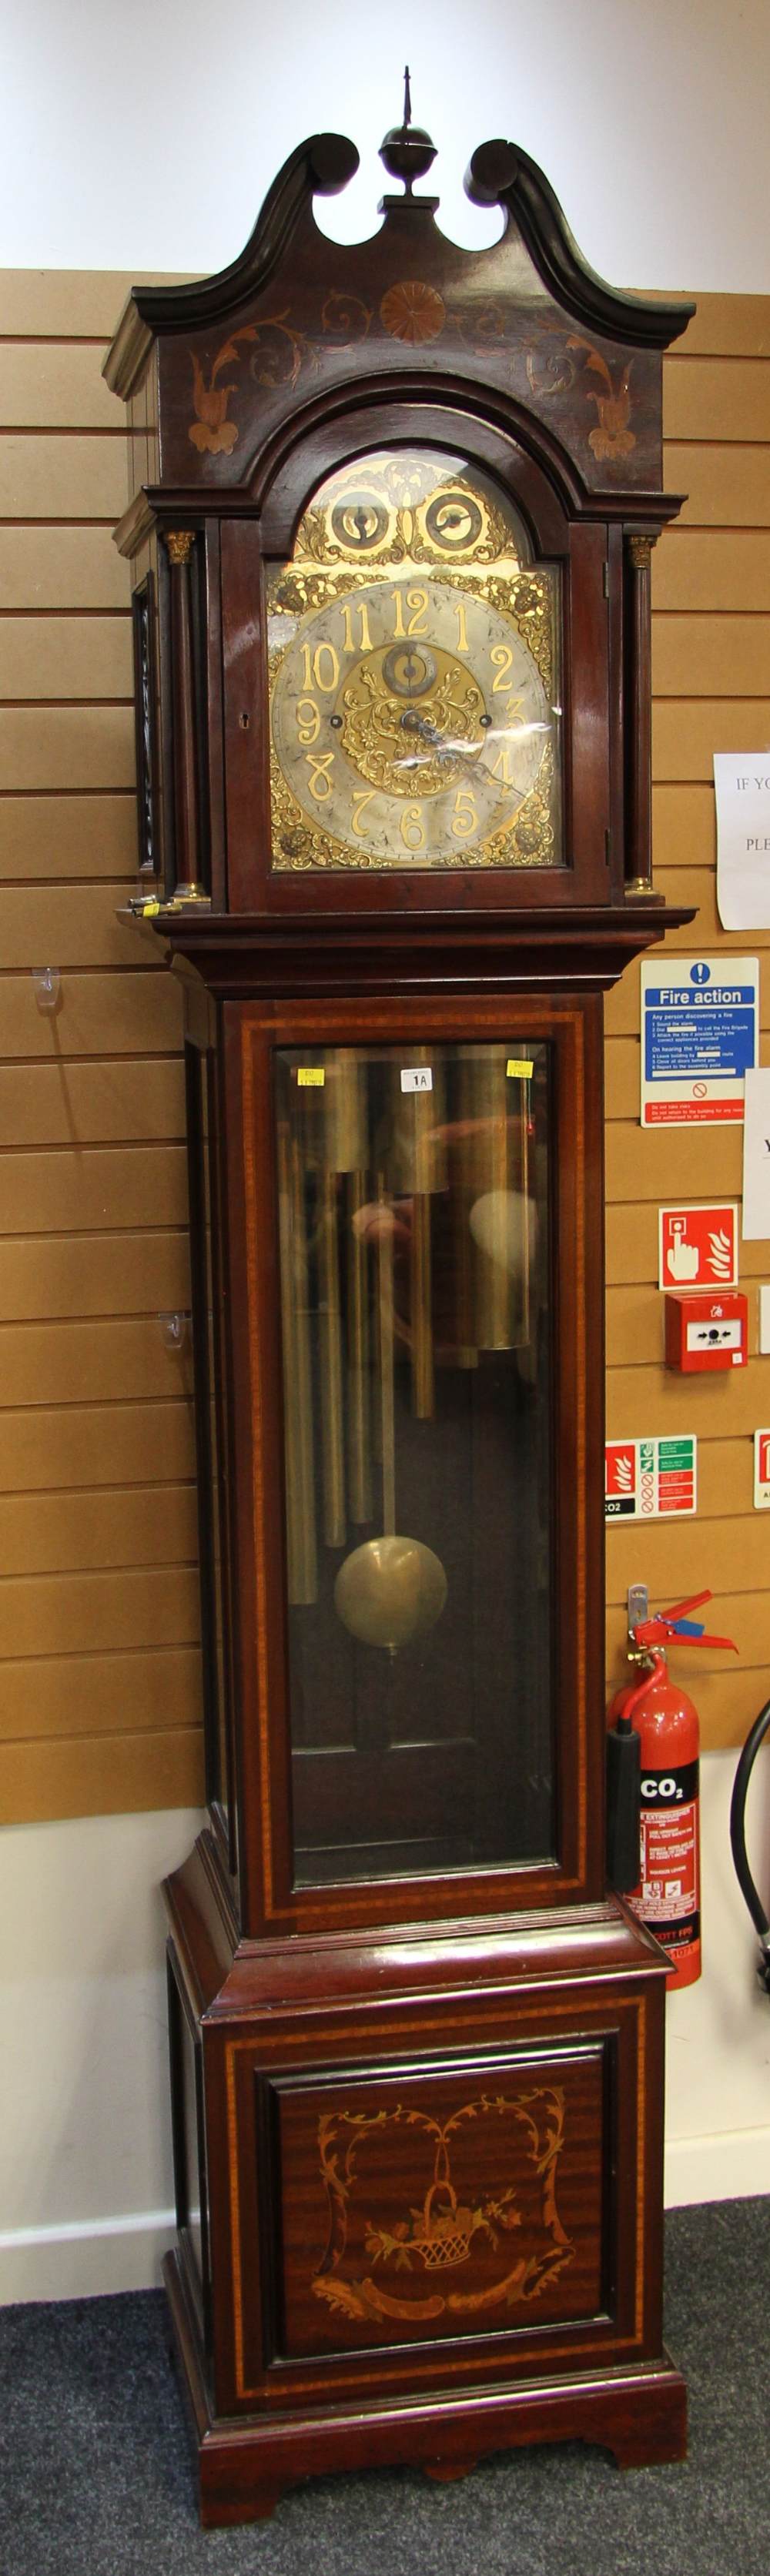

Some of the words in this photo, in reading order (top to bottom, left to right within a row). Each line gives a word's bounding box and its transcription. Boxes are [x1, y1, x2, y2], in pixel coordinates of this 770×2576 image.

[340, 604, 373, 652] 11
[391, 590, 428, 637] 12
[455, 604, 469, 652] 1
[300, 644, 340, 691] 10
[490, 645, 513, 693] 2
[297, 698, 320, 745] 9
[505, 698, 527, 742] 3
[306, 752, 335, 801] 8
[487, 751, 514, 795] 4
[737, 778, 750, 790] IF
[351, 791, 377, 837] 7
[399, 805, 425, 851] 6
[452, 791, 477, 838] 5
[660, 990, 689, 1004] Fire
[694, 989, 742, 1004] action
[641, 1778, 683, 1798] CO2
